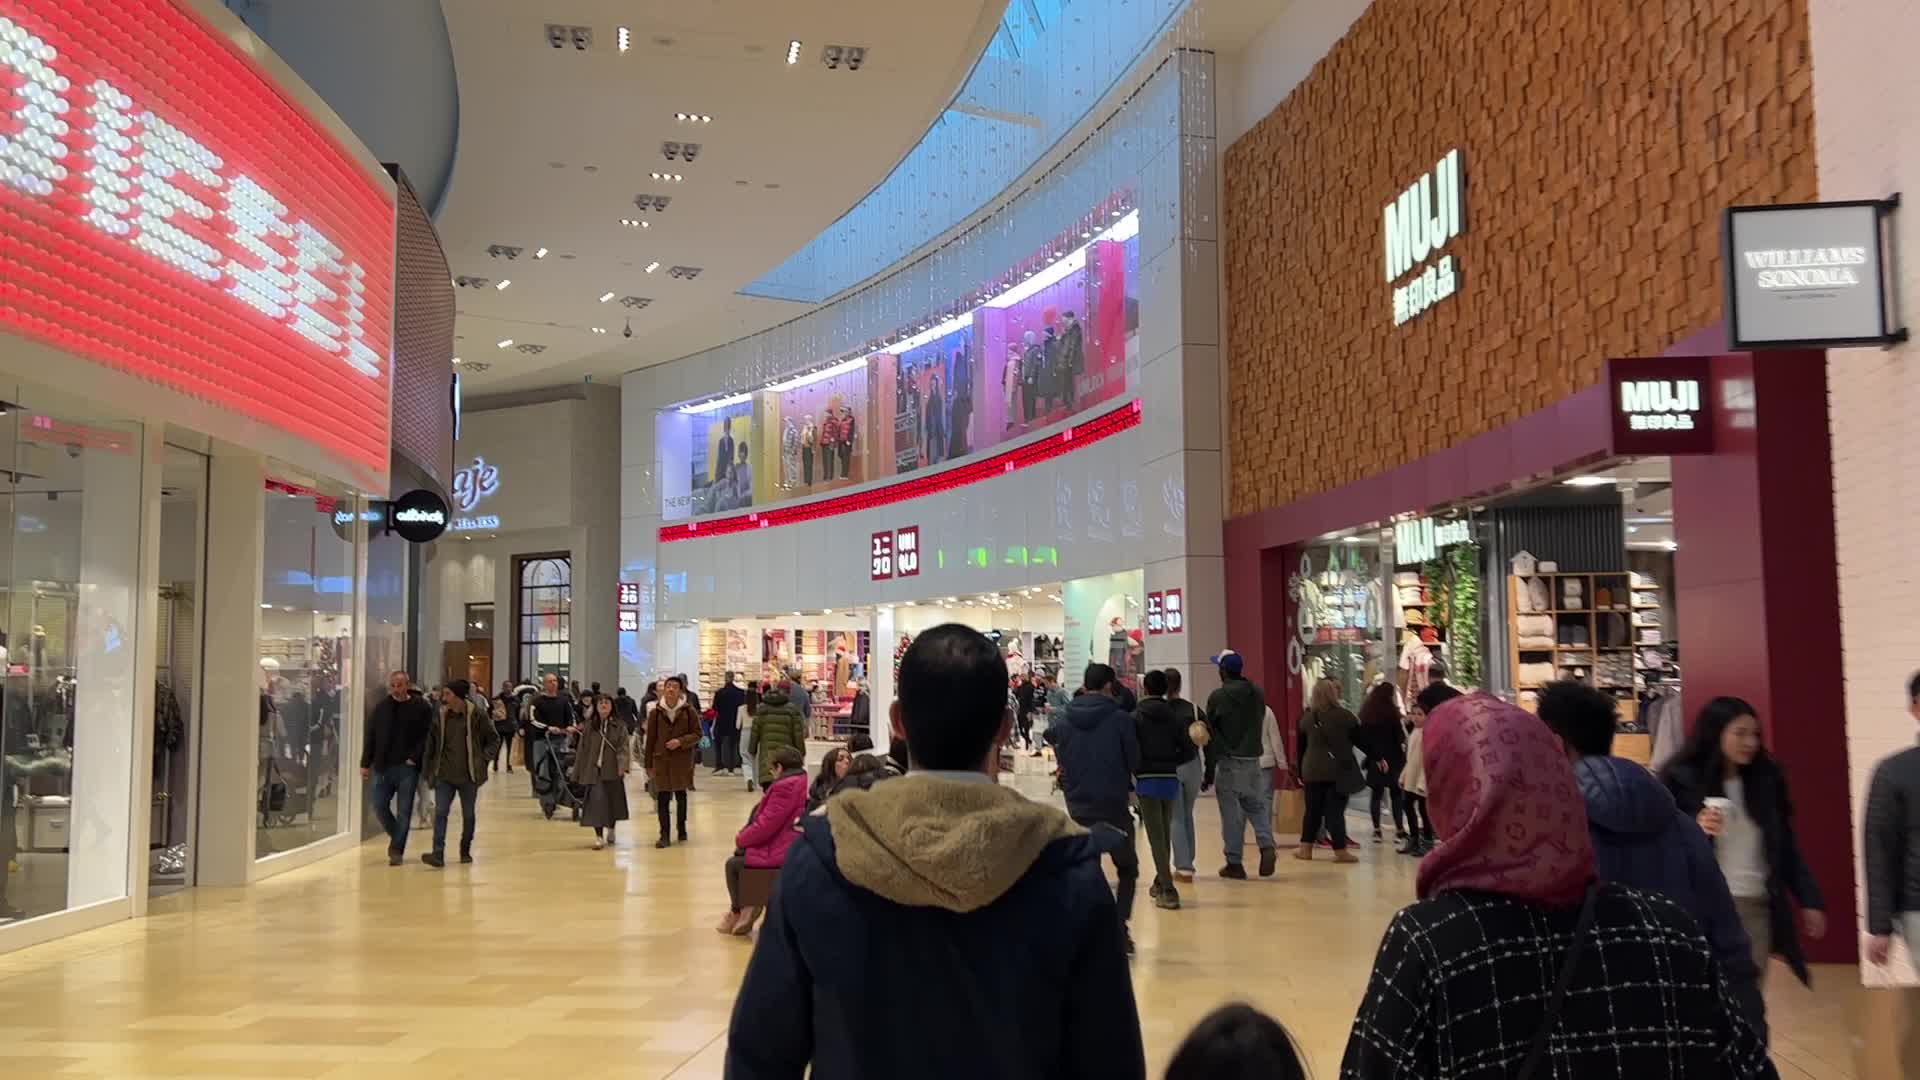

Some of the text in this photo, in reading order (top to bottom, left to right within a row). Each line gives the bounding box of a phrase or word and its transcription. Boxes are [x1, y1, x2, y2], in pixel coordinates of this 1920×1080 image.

[1384, 149, 1460, 284] MUJI
[1743, 247, 1866, 269] WILLIAMS
[1758, 267, 1860, 288] SONOMA
[1621, 380, 1700, 412] MUJI
